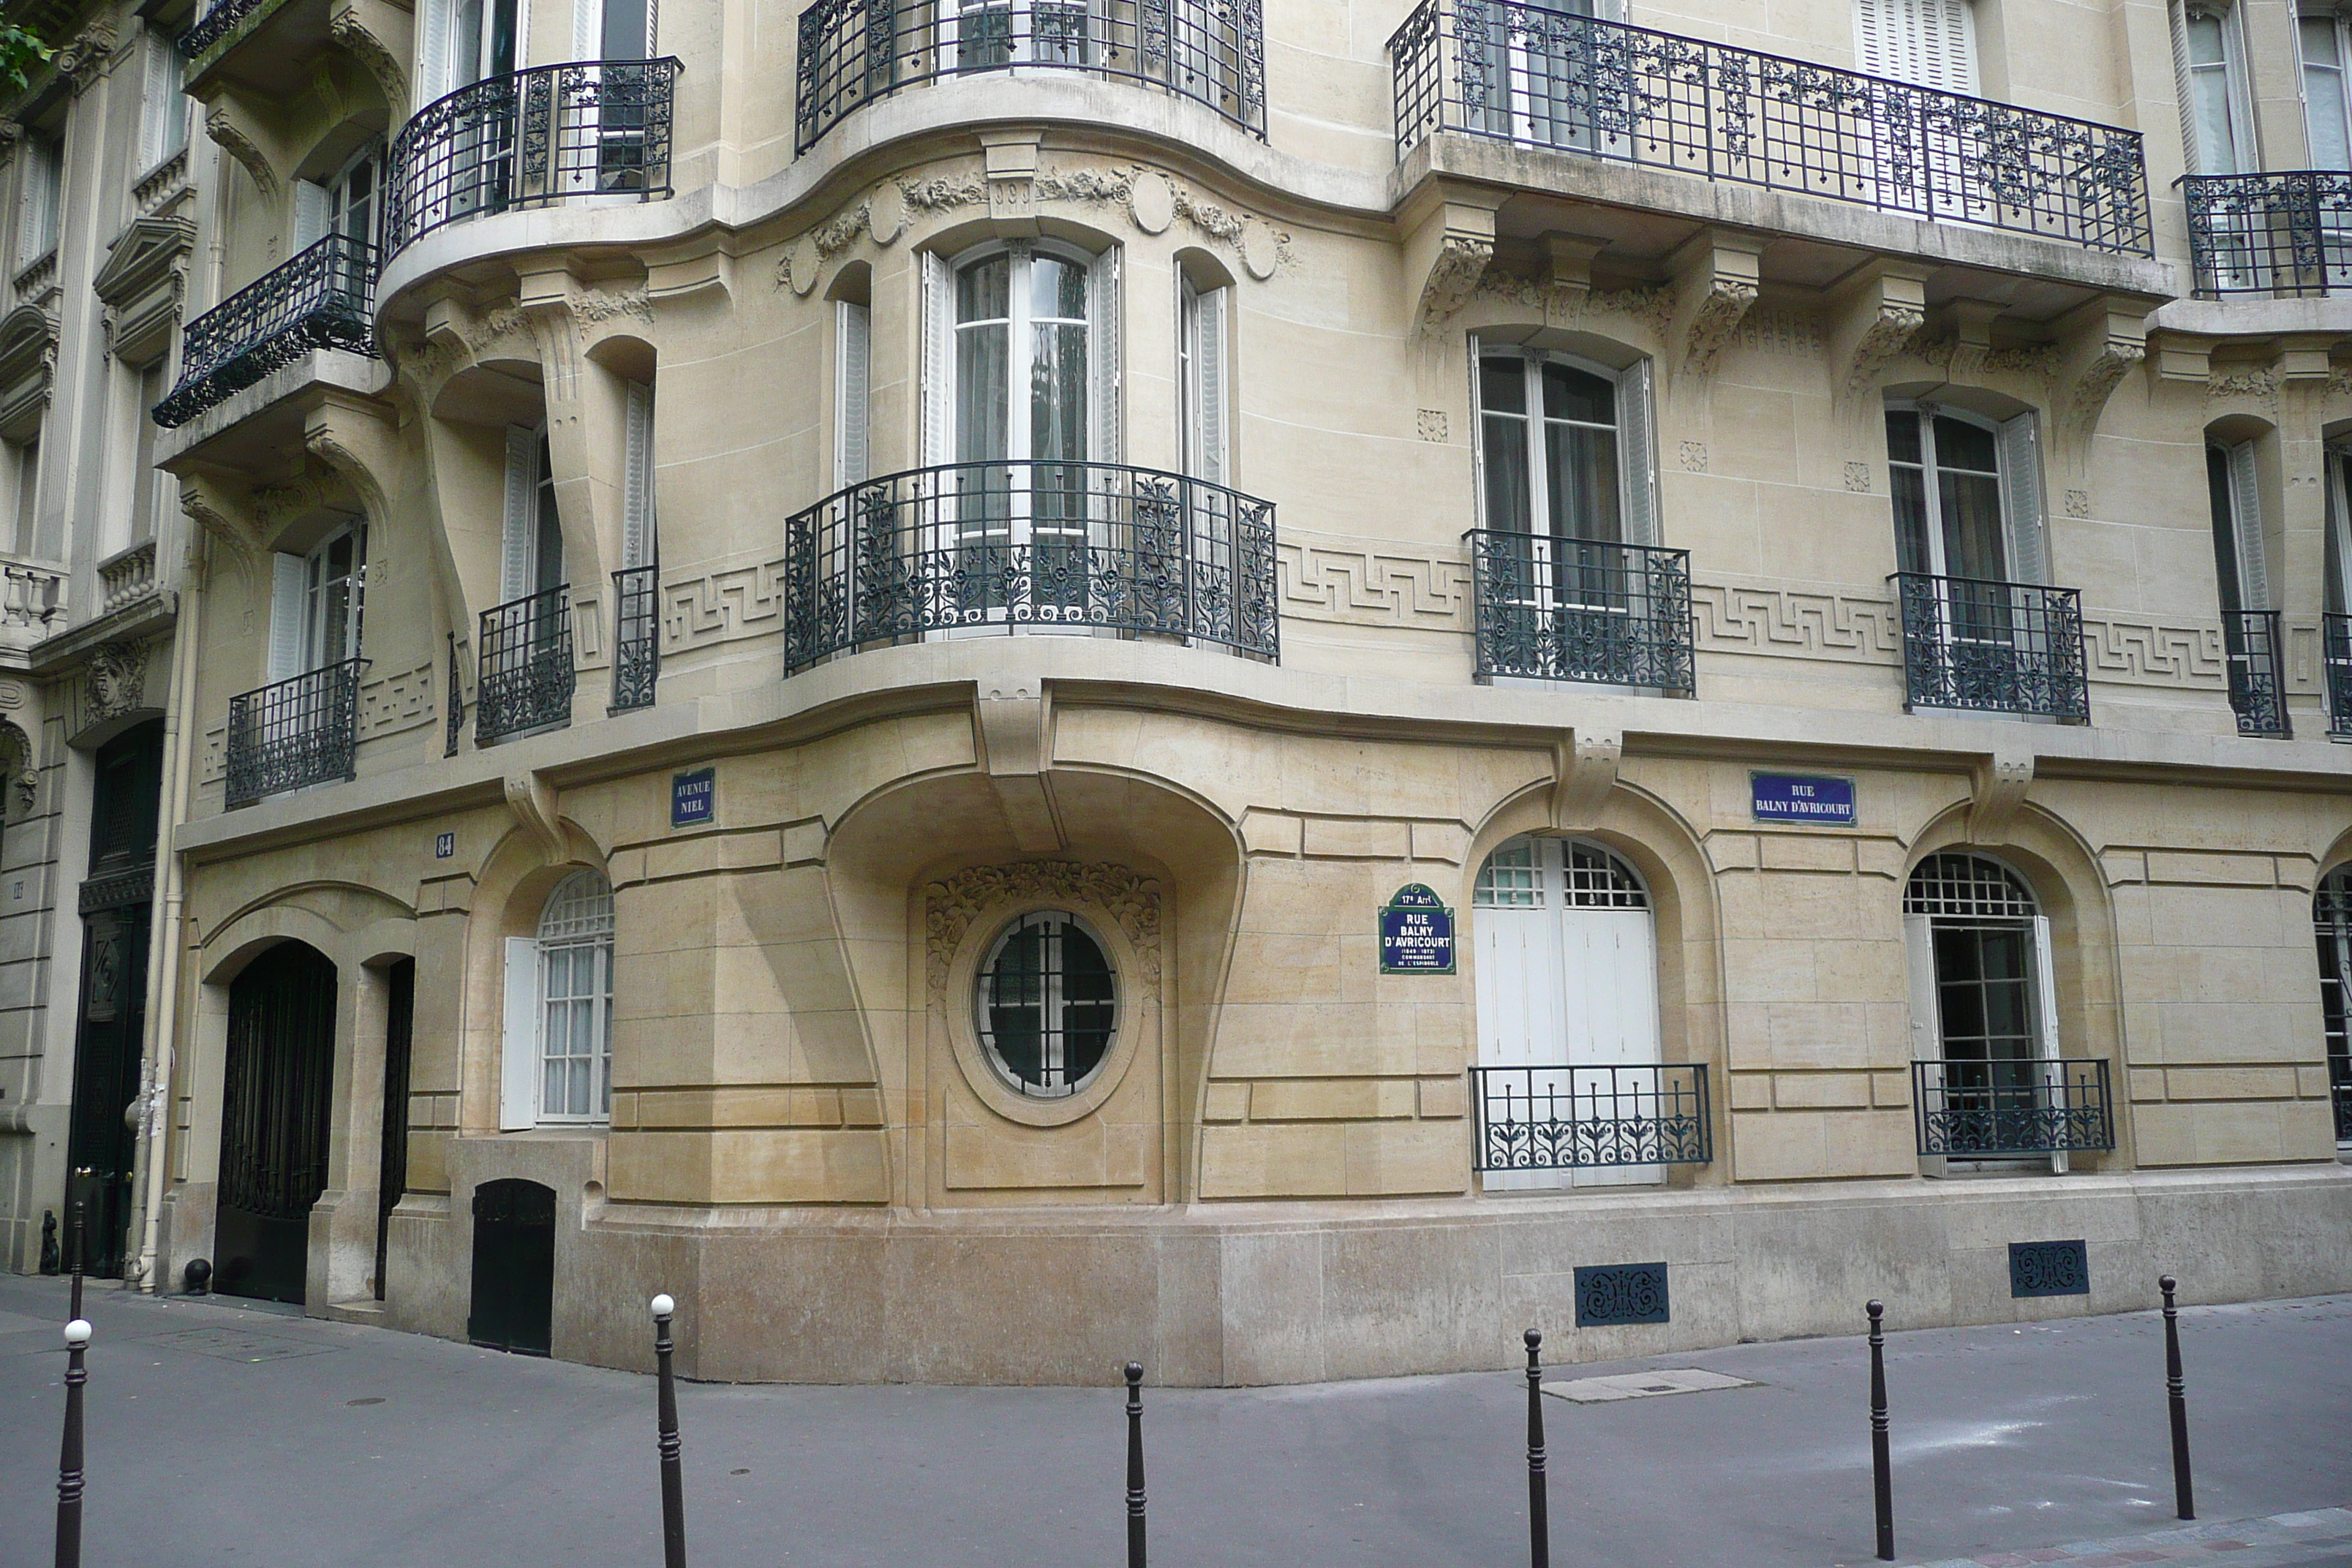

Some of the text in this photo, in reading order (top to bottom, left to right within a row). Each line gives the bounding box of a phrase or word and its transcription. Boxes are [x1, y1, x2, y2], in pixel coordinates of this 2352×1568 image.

[676, 780, 711, 798] AVENUE
[1791, 785, 1815, 797] RUE
[681, 799, 704, 814] NIEL
[1755, 799, 1852, 815] BALNY D'AVRICOURT
[438, 834, 452, 856] 84
[1406, 914, 1429, 925] RUE
[1400, 926, 1434, 937] BALNY
[1384, 936, 1450, 948] D'AVRICOURT
